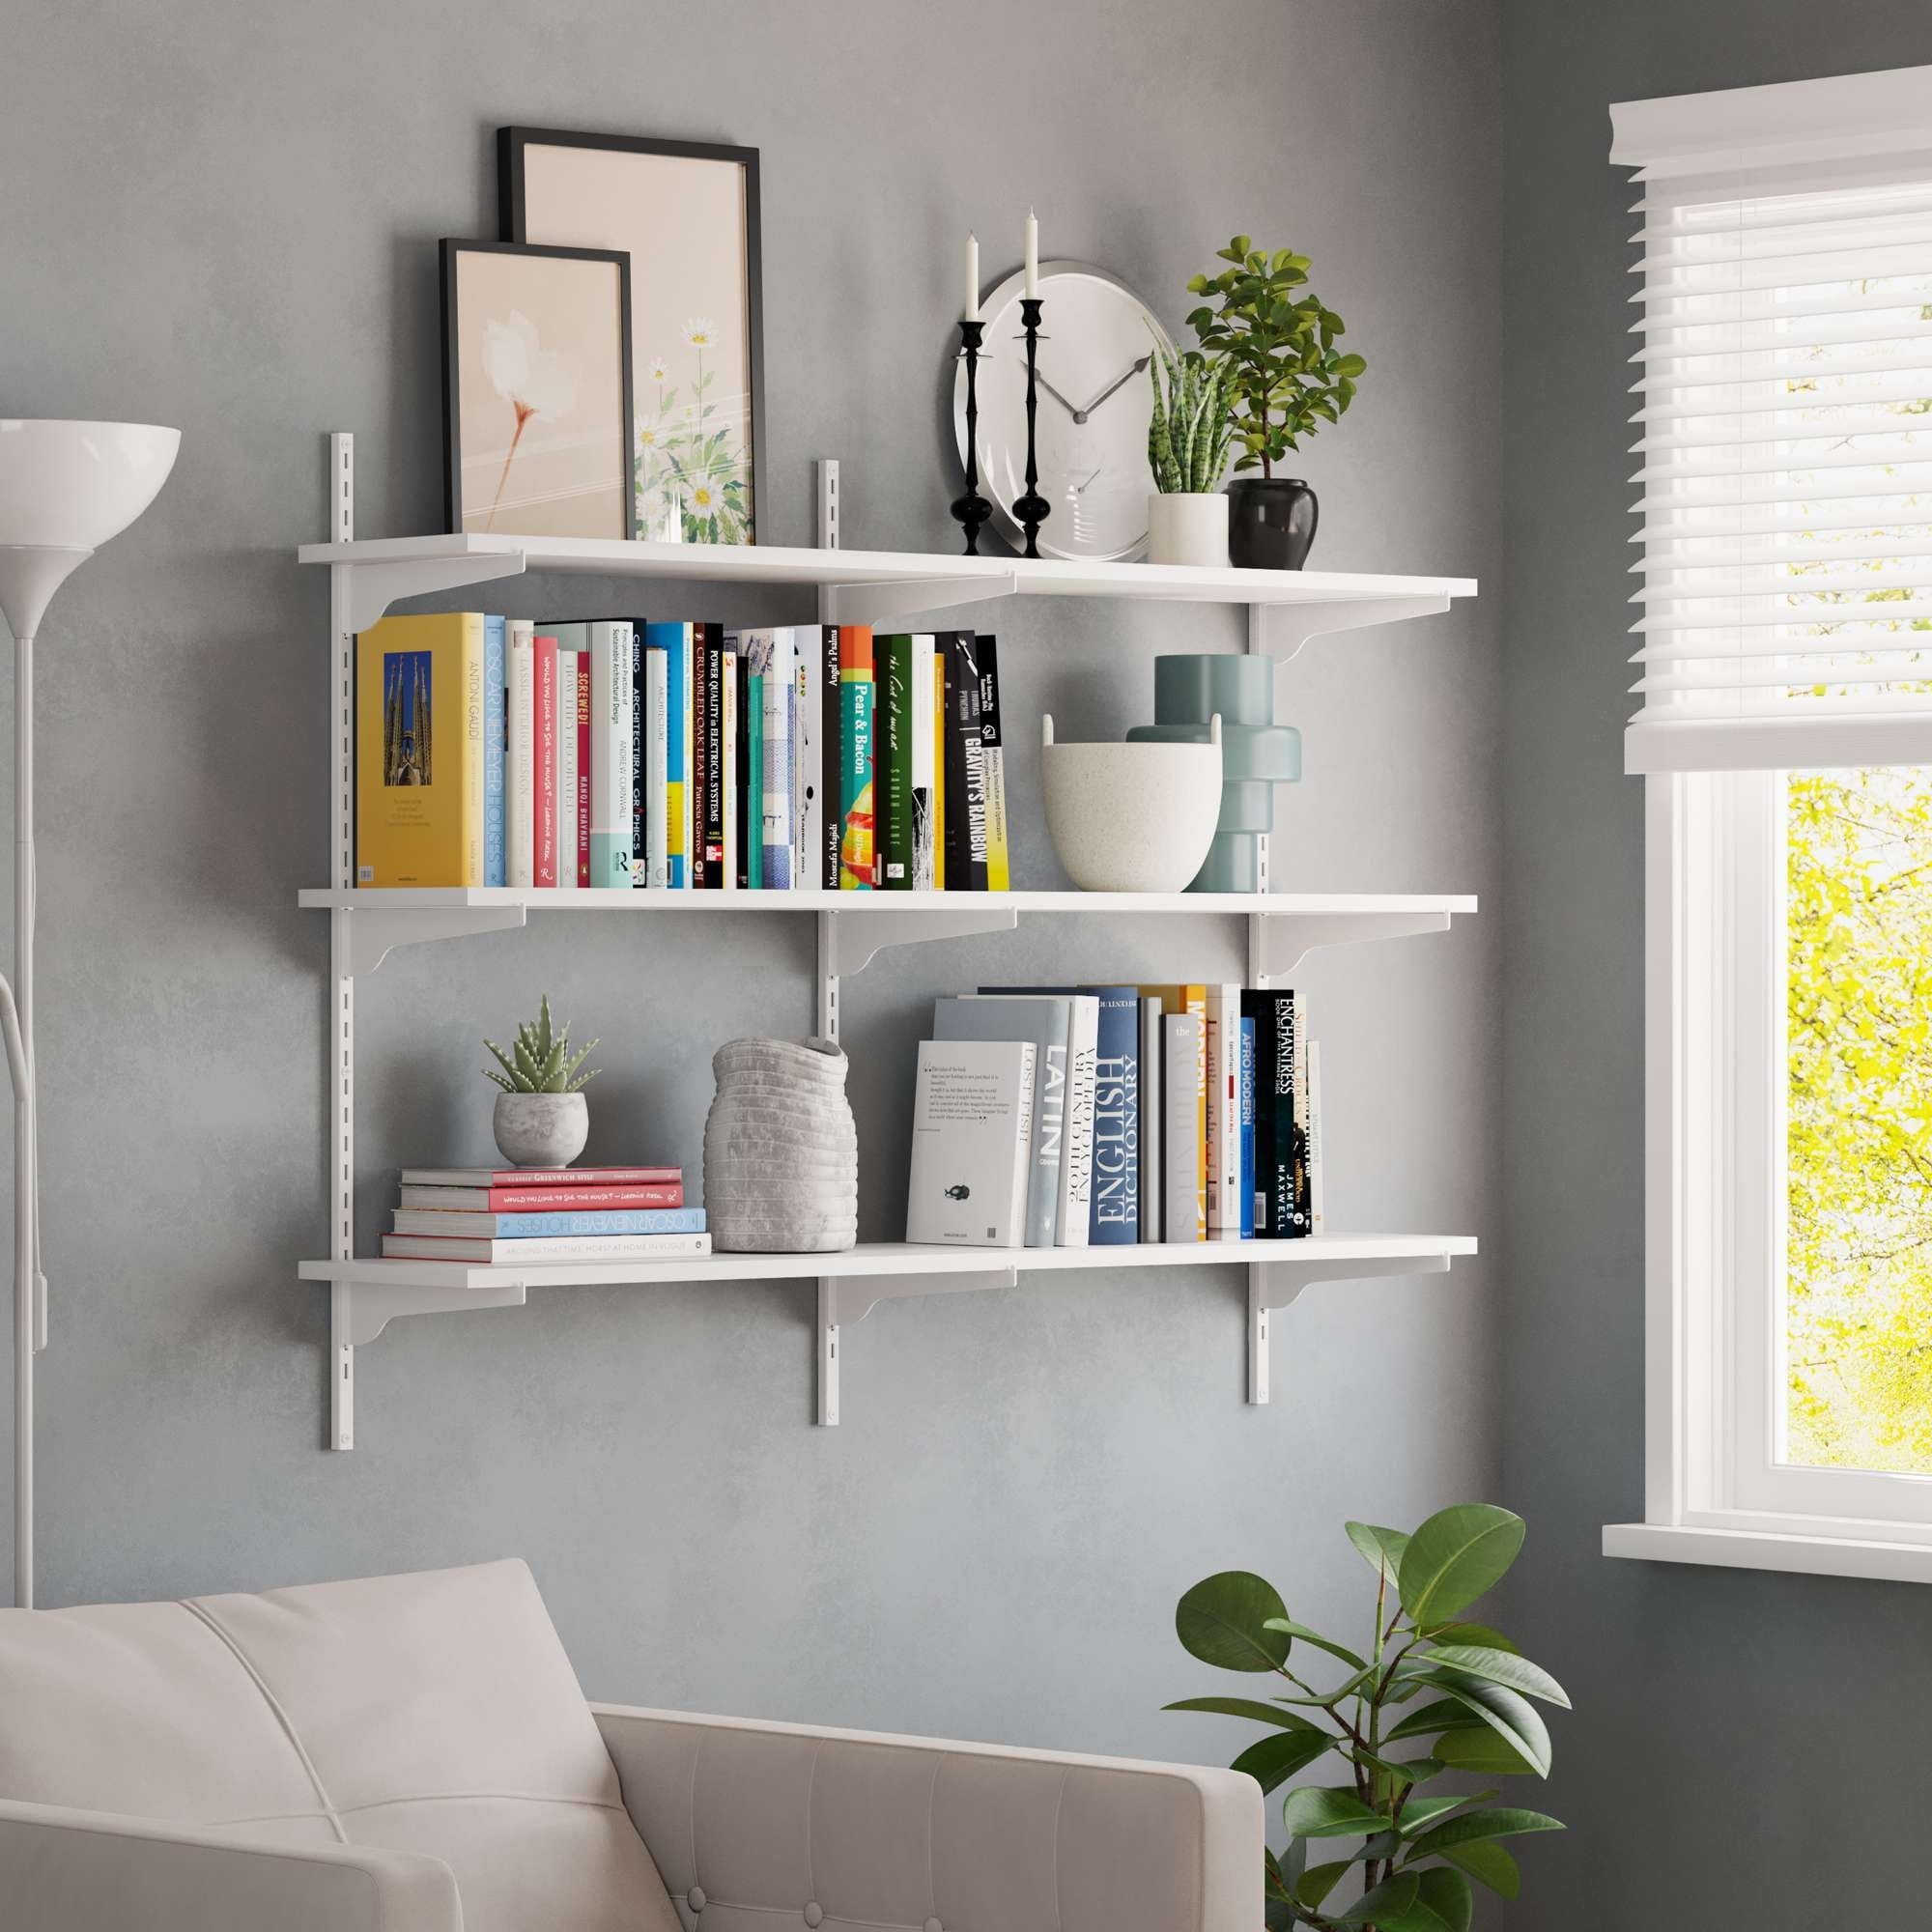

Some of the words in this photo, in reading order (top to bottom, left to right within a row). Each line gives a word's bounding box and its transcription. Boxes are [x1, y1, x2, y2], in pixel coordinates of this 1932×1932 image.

[633, 634, 641, 673] CHING
[710, 650, 719, 679] POWER
[828, 630, 838, 656] Psalms
[469, 660, 480, 703] ANTONI
[486, 641, 502, 705] OSCAR
[696, 646, 705, 715] CRUMBLED
[611, 704, 620, 724] Design
[708, 680, 719, 718] QUALITY
[855, 685, 867, 716] Pear
[959, 690, 970, 722] PYNCHON
[519, 699, 530, 752] INTERIOR
[633, 688, 641, 781] ARCHITECTURAL
[696, 717, 705, 746] OAK
[855, 719, 867, 731] &
[486, 707, 502, 792] NIEMEYER
[696, 748, 705, 779] LEAF
[710, 728, 719, 781] ELECTRICAL
[855, 734, 868, 774] Bacon
[965, 737, 984, 803] GRAVITY'S
[519, 754, 530, 795] DESIGN
[579, 776, 588, 804] MANOJ
[890, 768, 900, 808] SARAH
[633, 788, 644, 850] GRAPHICS
[710, 782, 719, 822] SYSTEMS
[486, 795, 502, 866] HOUSES
[579, 808, 588, 851] BHAVNANI
[968, 804, 987, 863] RAINBOW
[1176, 1026, 1190, 1037] the
[1242, 1033, 1252, 1067] AFRO
[1279, 998, 1294, 1094] ENCHANTRESS
[1022, 1048, 1035, 1096] LOST
[1039, 1044, 1066, 1156] LATIN
[1070, 1049, 1085, 1141] CENTURY
[1242, 1069, 1252, 1125] MODERN
[1019, 1100, 1031, 1143] FISH
[1078, 1046, 1095, 1203] ENCYCLOPEDIA
[1095, 1054, 1125, 1226] ENGLISH
[1124, 1054, 1138, 1224] DICTIONARY
[533, 1173, 574, 1182] GREENWICH
[1277, 1164, 1287, 1231] MAXWELL
[1286, 1174, 1294, 1219] JAMES
[517, 1217, 572, 1236] HOUSES
[573, 1214, 639, 1234] NIEMEYER
[639, 1213, 686, 1232] OSCAR
